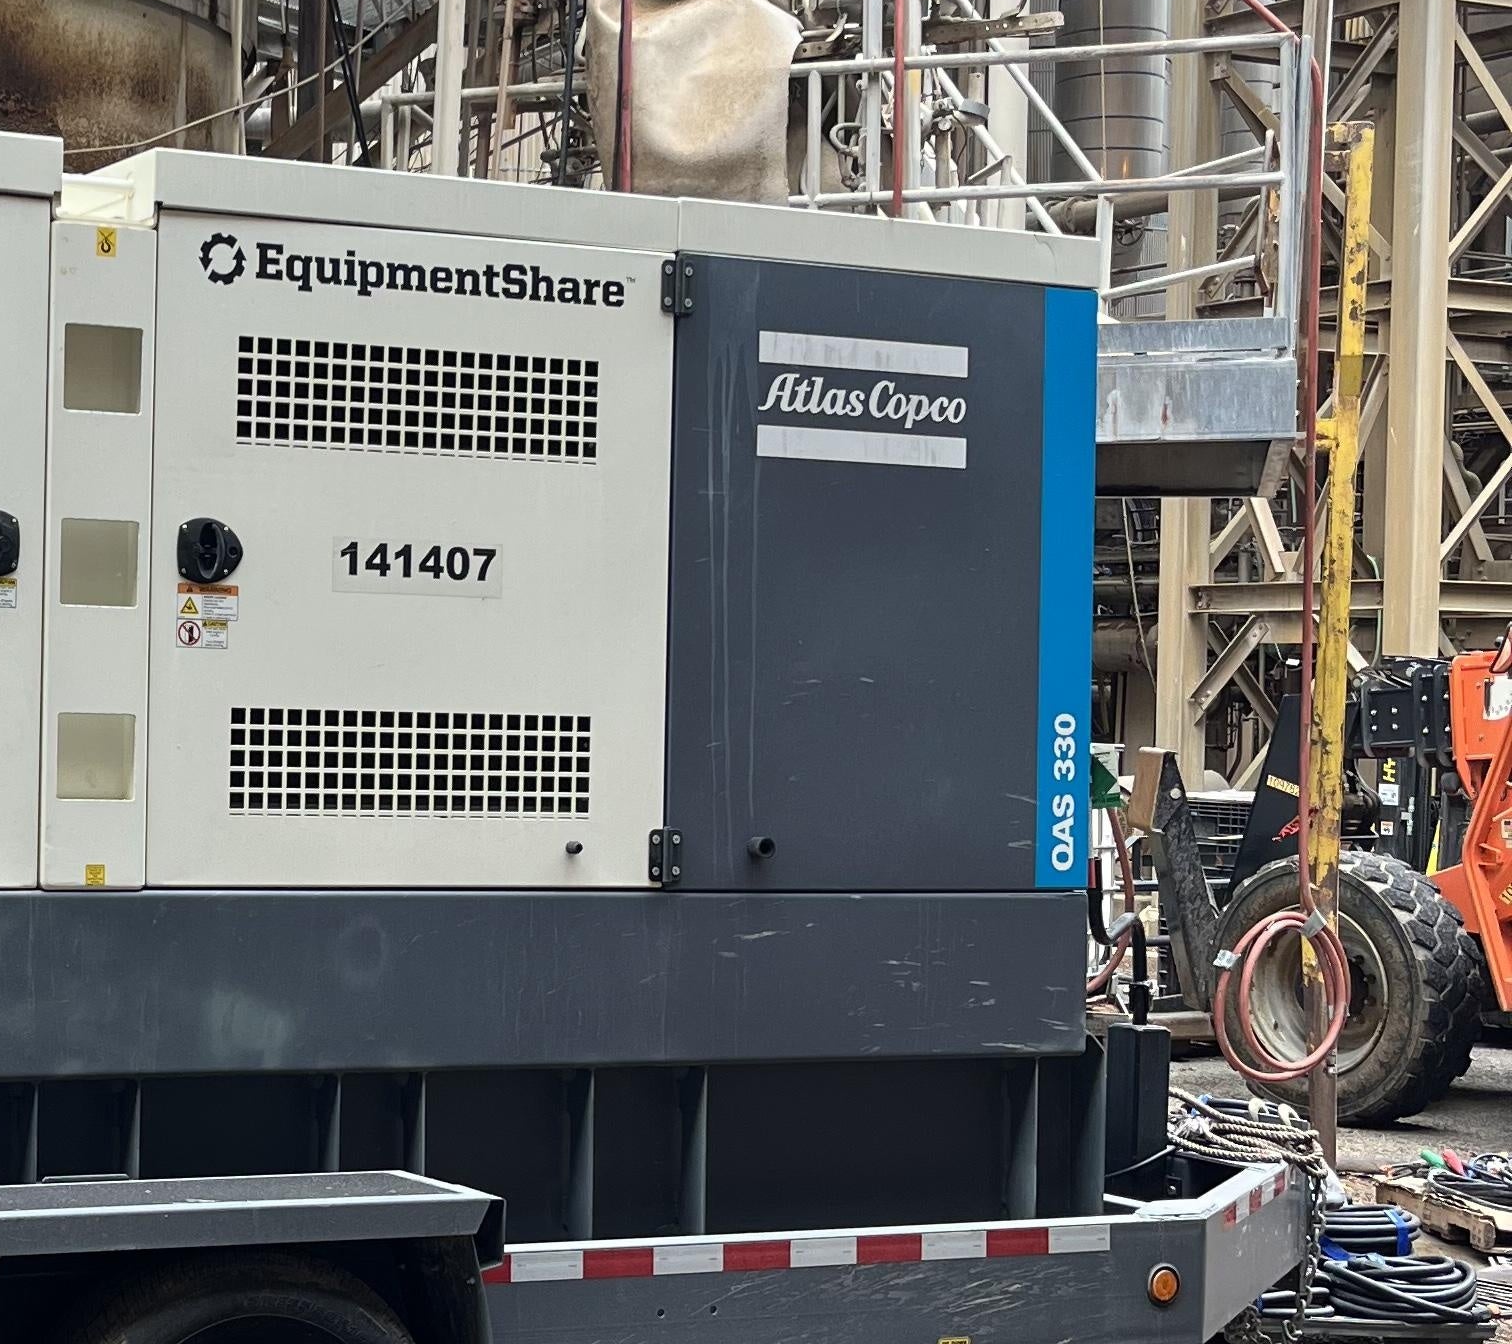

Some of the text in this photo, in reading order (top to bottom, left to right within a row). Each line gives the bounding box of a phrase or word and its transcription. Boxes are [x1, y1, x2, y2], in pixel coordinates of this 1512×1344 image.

[256, 242, 625, 308] EquipmentShare
[758, 373, 967, 429] Atlas Copco
[340, 541, 497, 582] 141407
[1051, 713, 1076, 872] QAS 330
